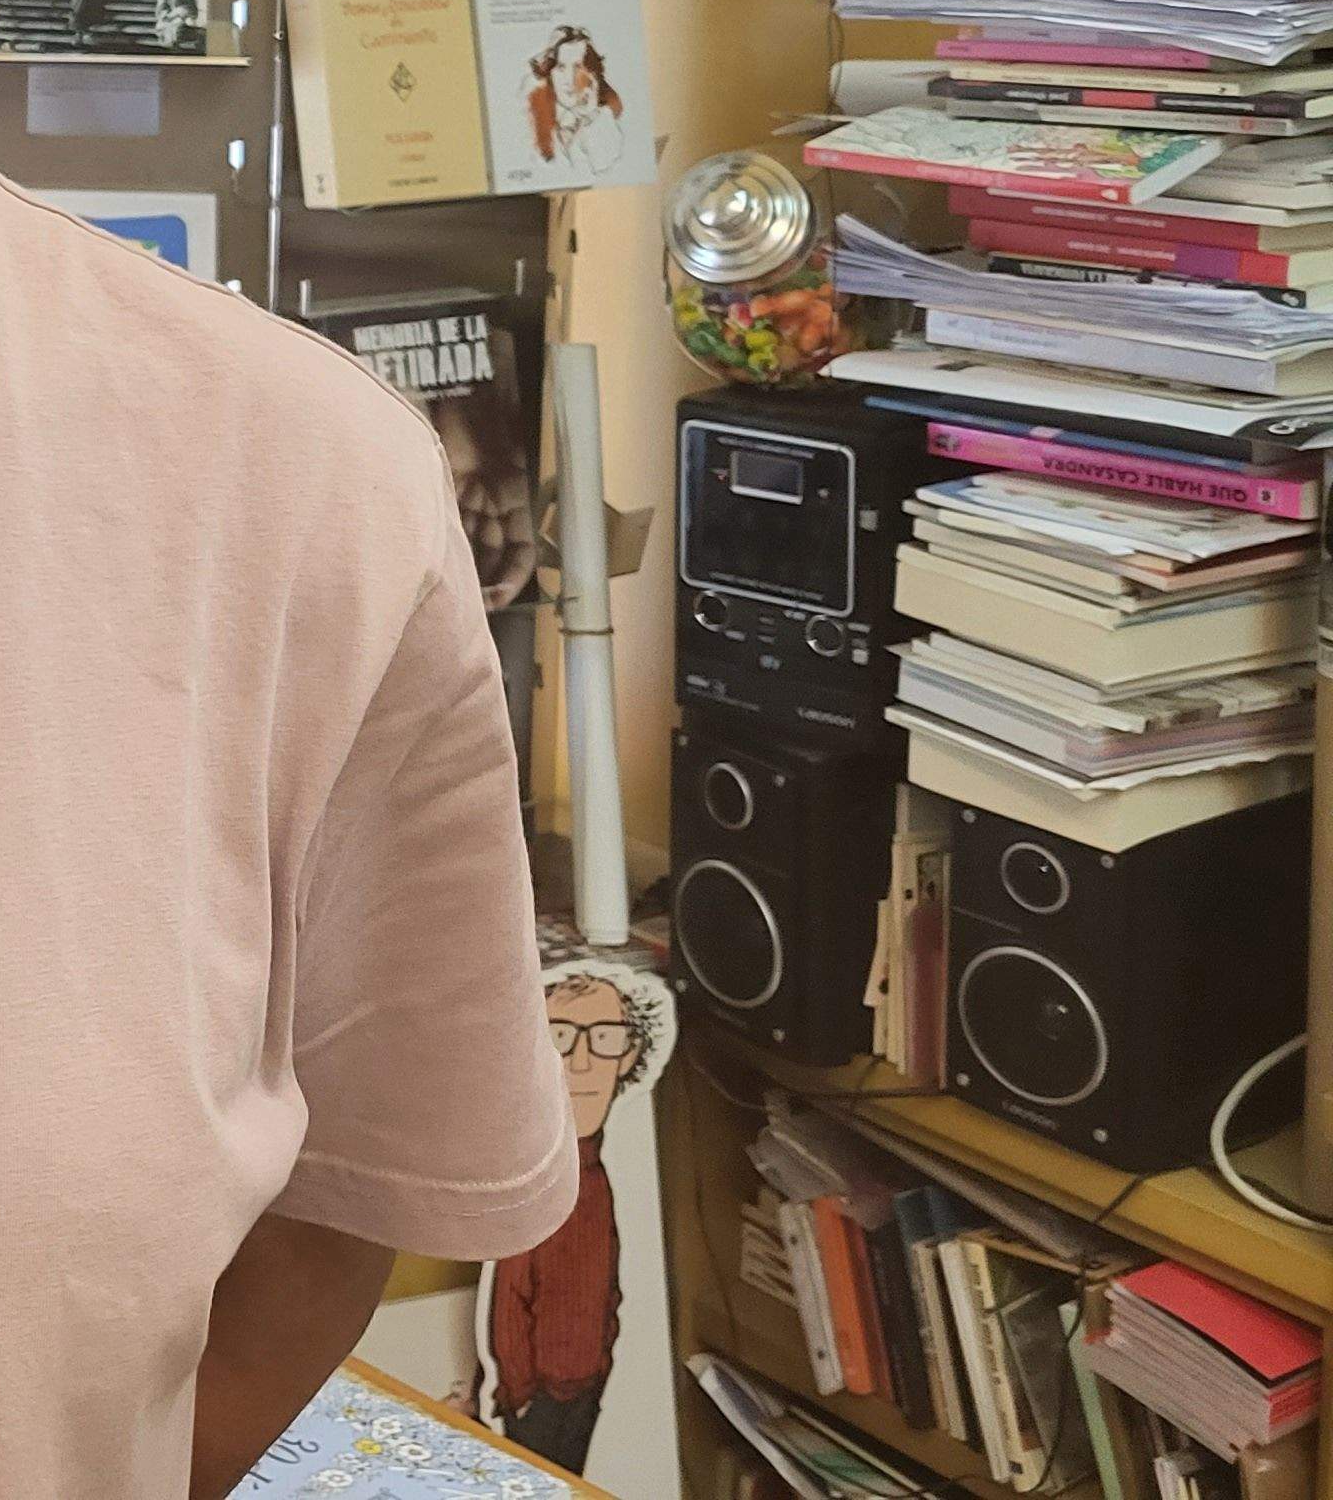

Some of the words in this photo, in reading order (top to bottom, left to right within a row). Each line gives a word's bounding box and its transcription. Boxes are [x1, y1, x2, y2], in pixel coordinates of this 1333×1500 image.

[1041, 456, 1141, 485] CASANDRA
[1144, 475, 1204, 497] HABLE
[1208, 486, 1248, 502] QUE
